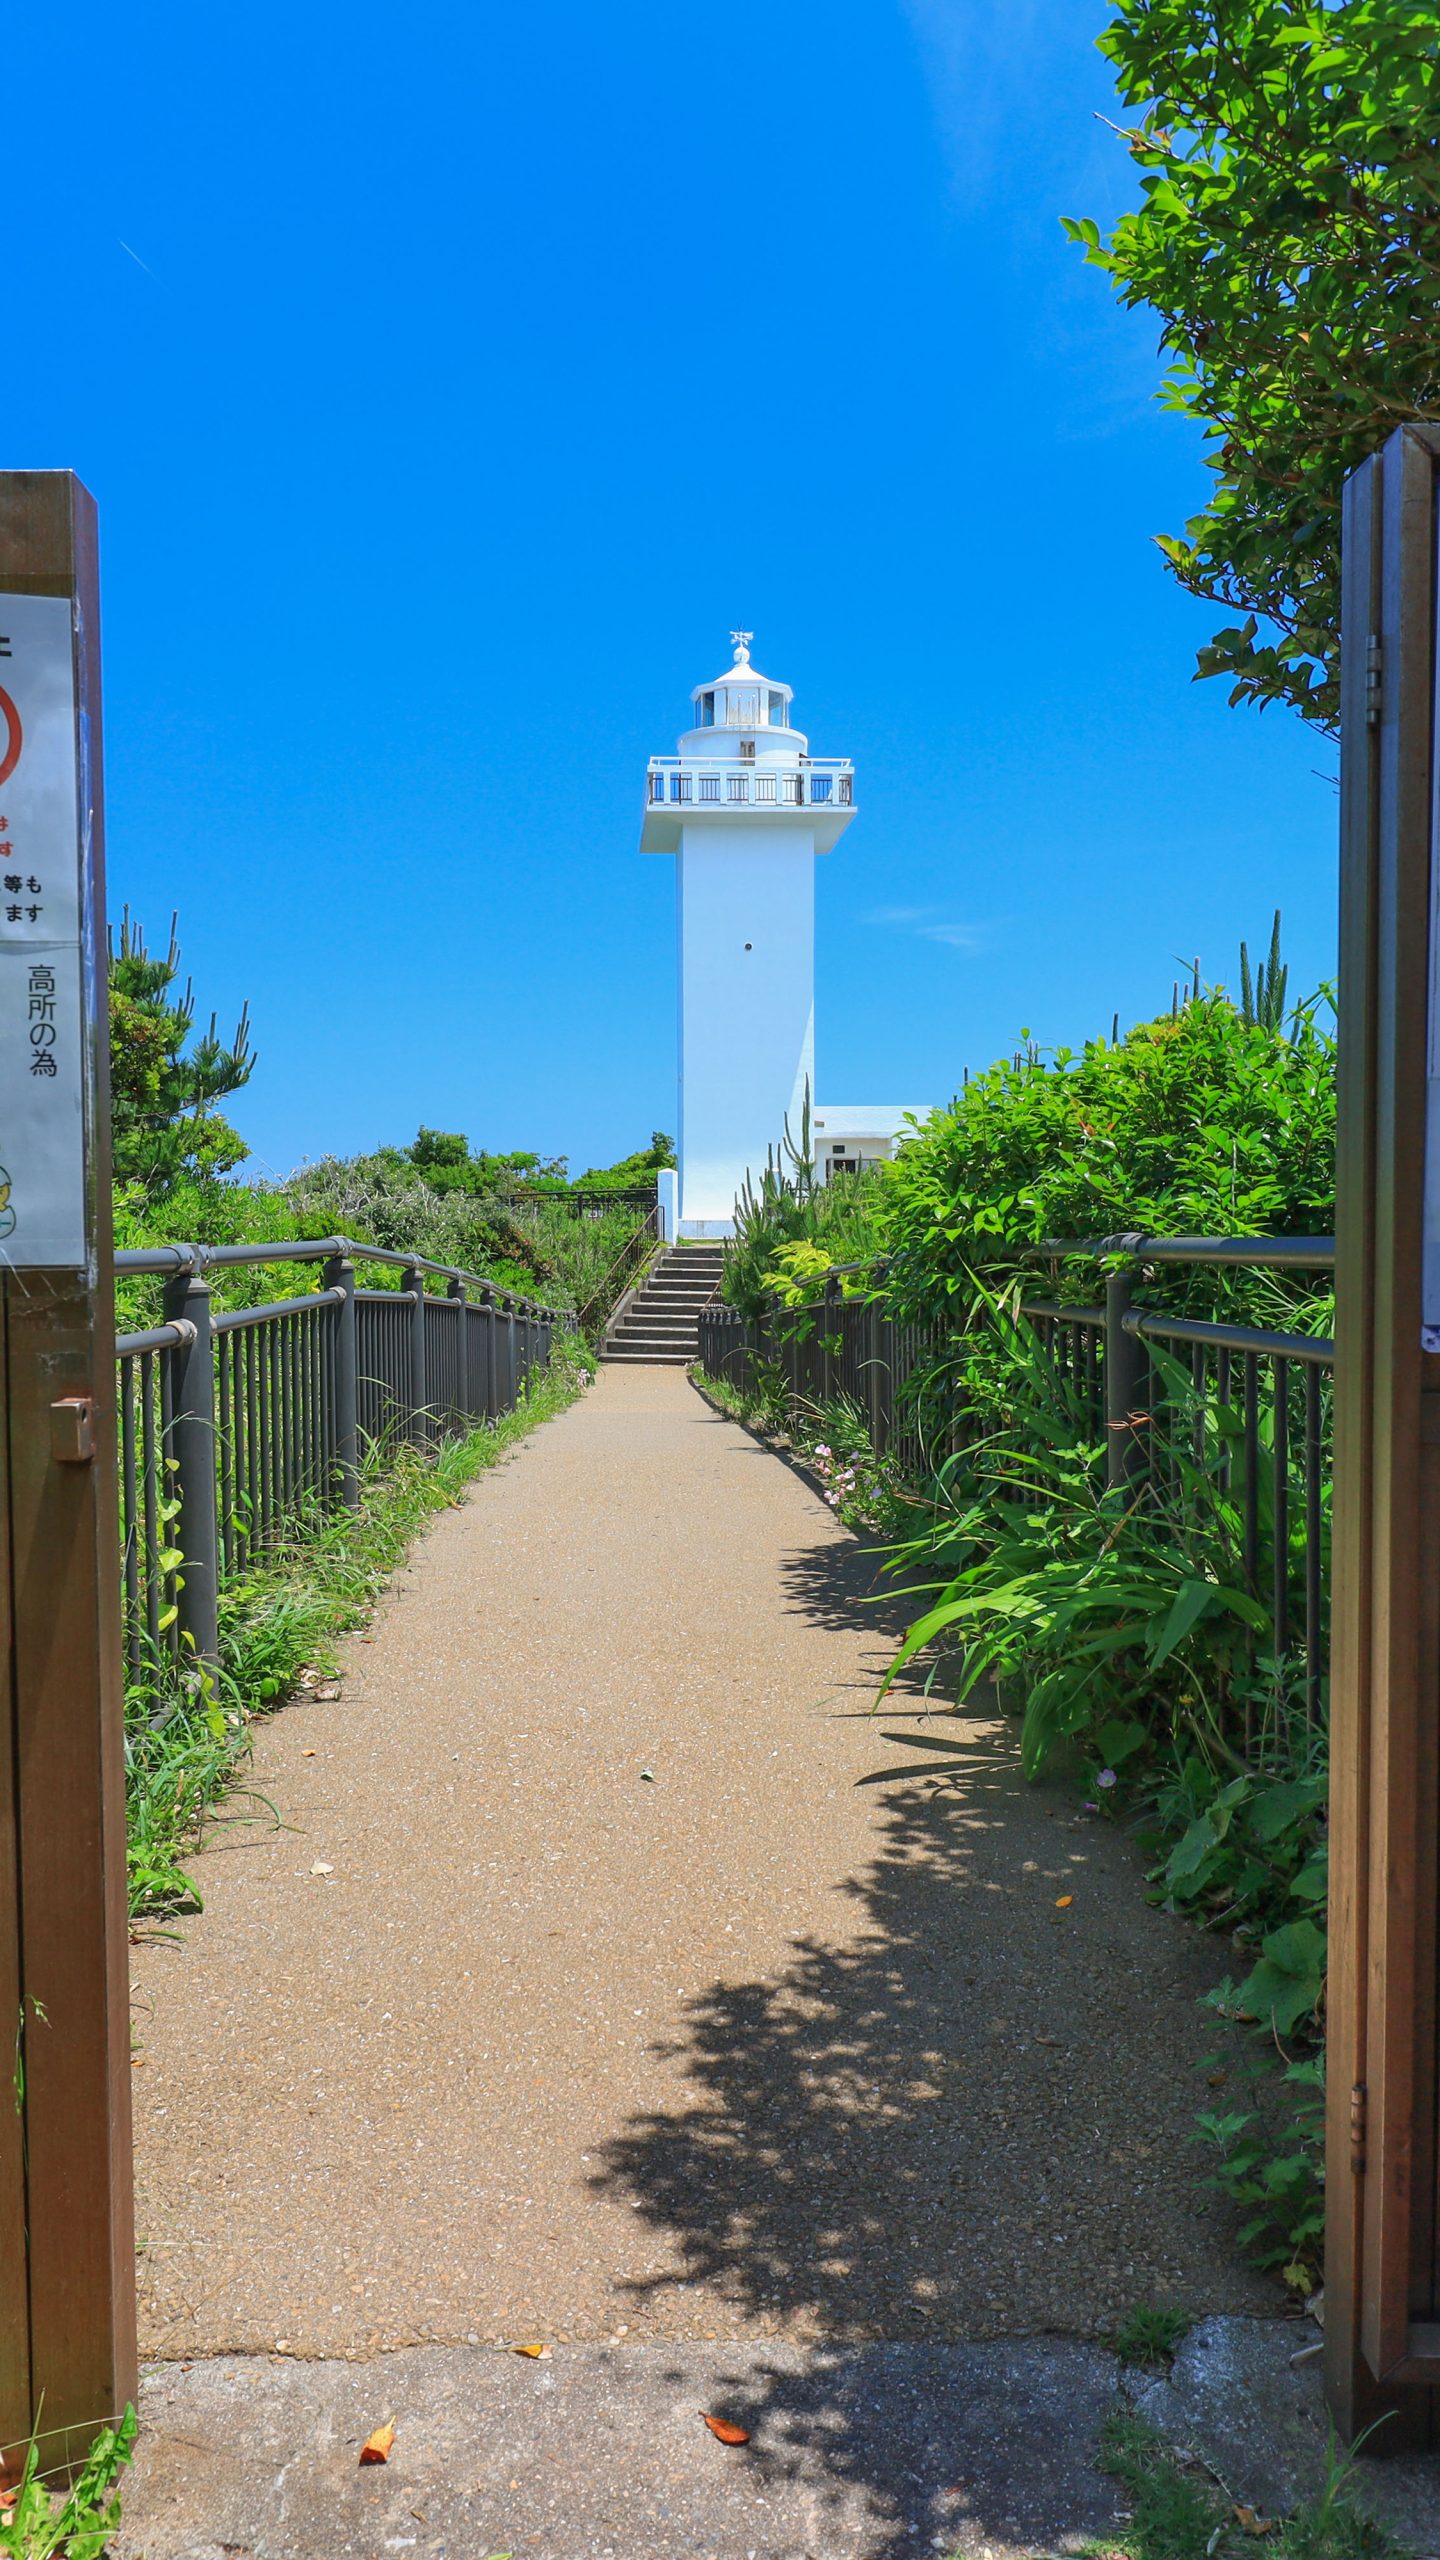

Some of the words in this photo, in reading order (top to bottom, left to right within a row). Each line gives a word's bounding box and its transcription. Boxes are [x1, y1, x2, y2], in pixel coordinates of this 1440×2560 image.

[4, 875, 42, 894] 等も
[5, 904, 44, 923] ます
[27, 964, 58, 1077] 高所の為
